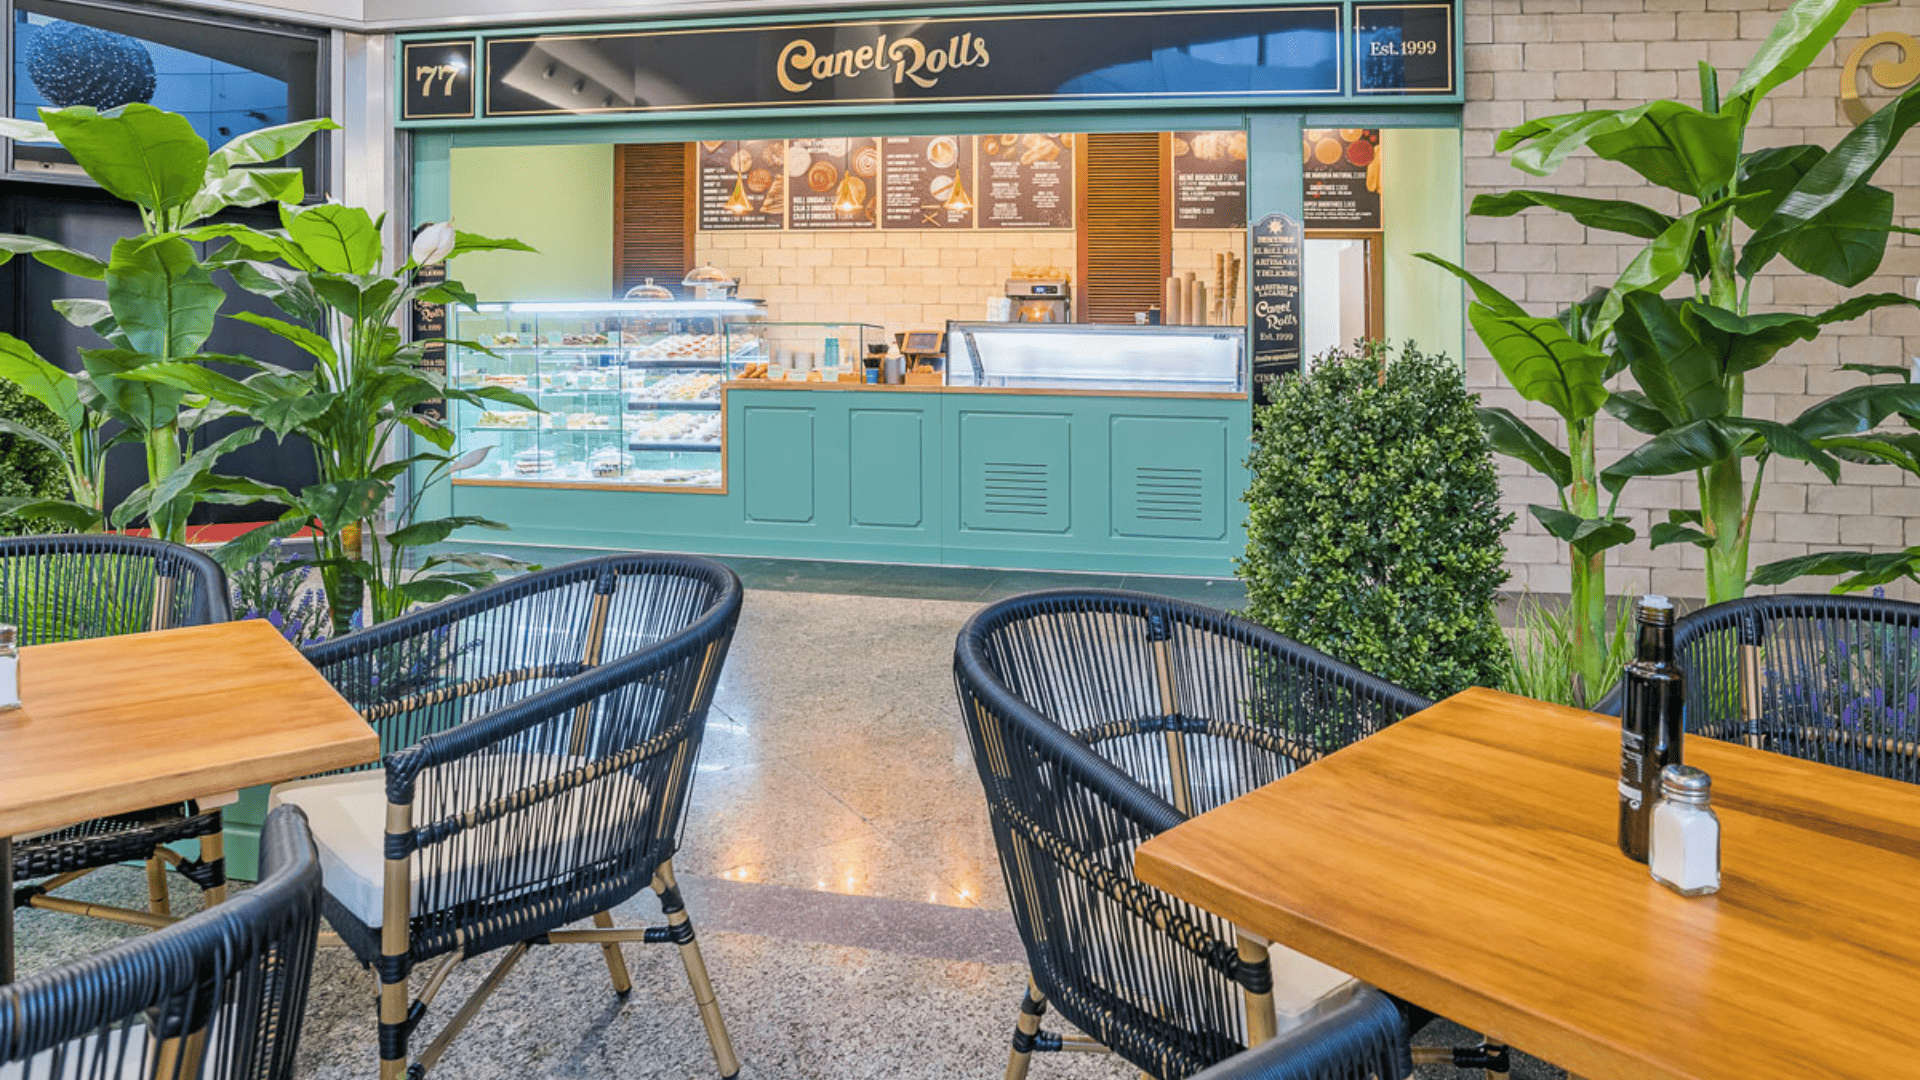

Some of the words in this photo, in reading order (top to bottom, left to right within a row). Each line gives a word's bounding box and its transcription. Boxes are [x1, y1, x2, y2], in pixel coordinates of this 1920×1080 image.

[1370, 41, 1400, 56] Est.
[1401, 40, 1437, 55] 1999
[777, 34, 890, 93] Canel
[888, 32, 990, 88] Rolls
[416, 65, 459, 97] 77
[1255, 299, 1292, 318] Canel
[1265, 313, 1298, 330] Rolls
[1276, 332, 1294, 341] 1999
